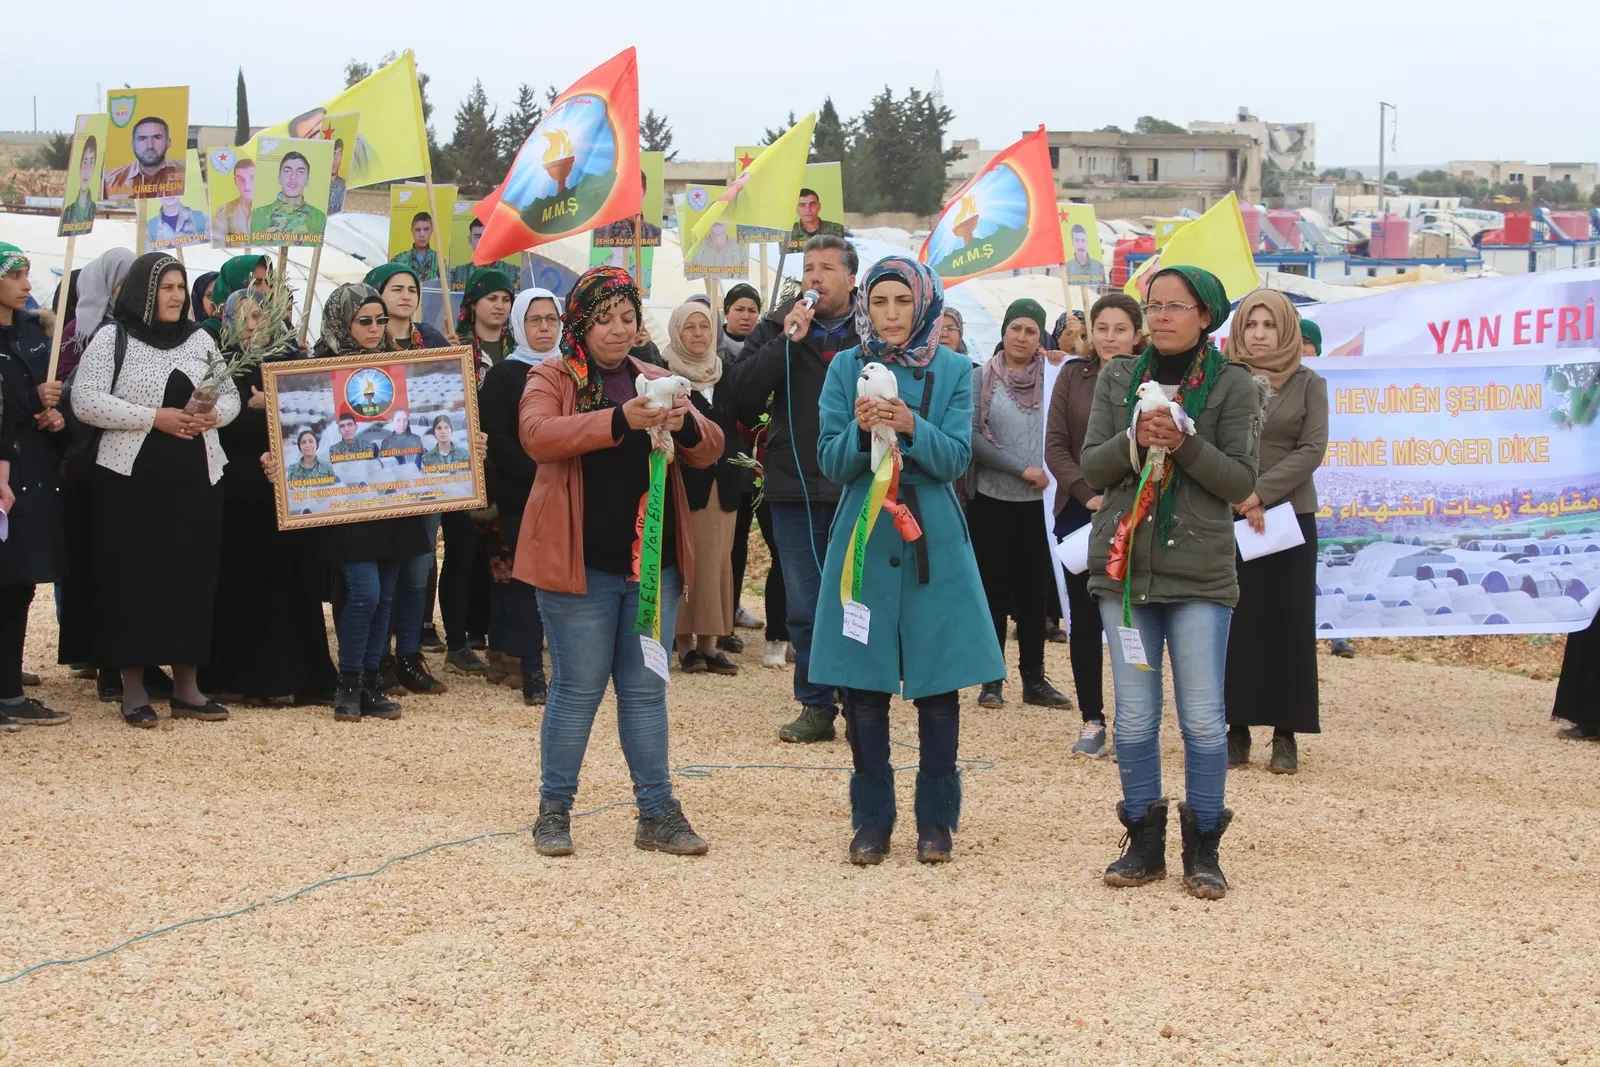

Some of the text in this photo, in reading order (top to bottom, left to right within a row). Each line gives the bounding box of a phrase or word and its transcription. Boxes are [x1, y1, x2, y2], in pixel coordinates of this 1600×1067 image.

[135, 184, 158, 194] UMER
[542, 197, 579, 222] M.M.Ş
[952, 244, 994, 268] M.M.Ş
[1427, 296, 1600, 354] YAN EFRÎ
[1319, 437, 1387, 467] FRÎNÊ
[1339, 494, 1436, 523] الشهداء
[1442, 500, 1512, 520] زوجات
[1518, 492, 1600, 518] مقاومة
[644, 525, 658, 555] Yan
